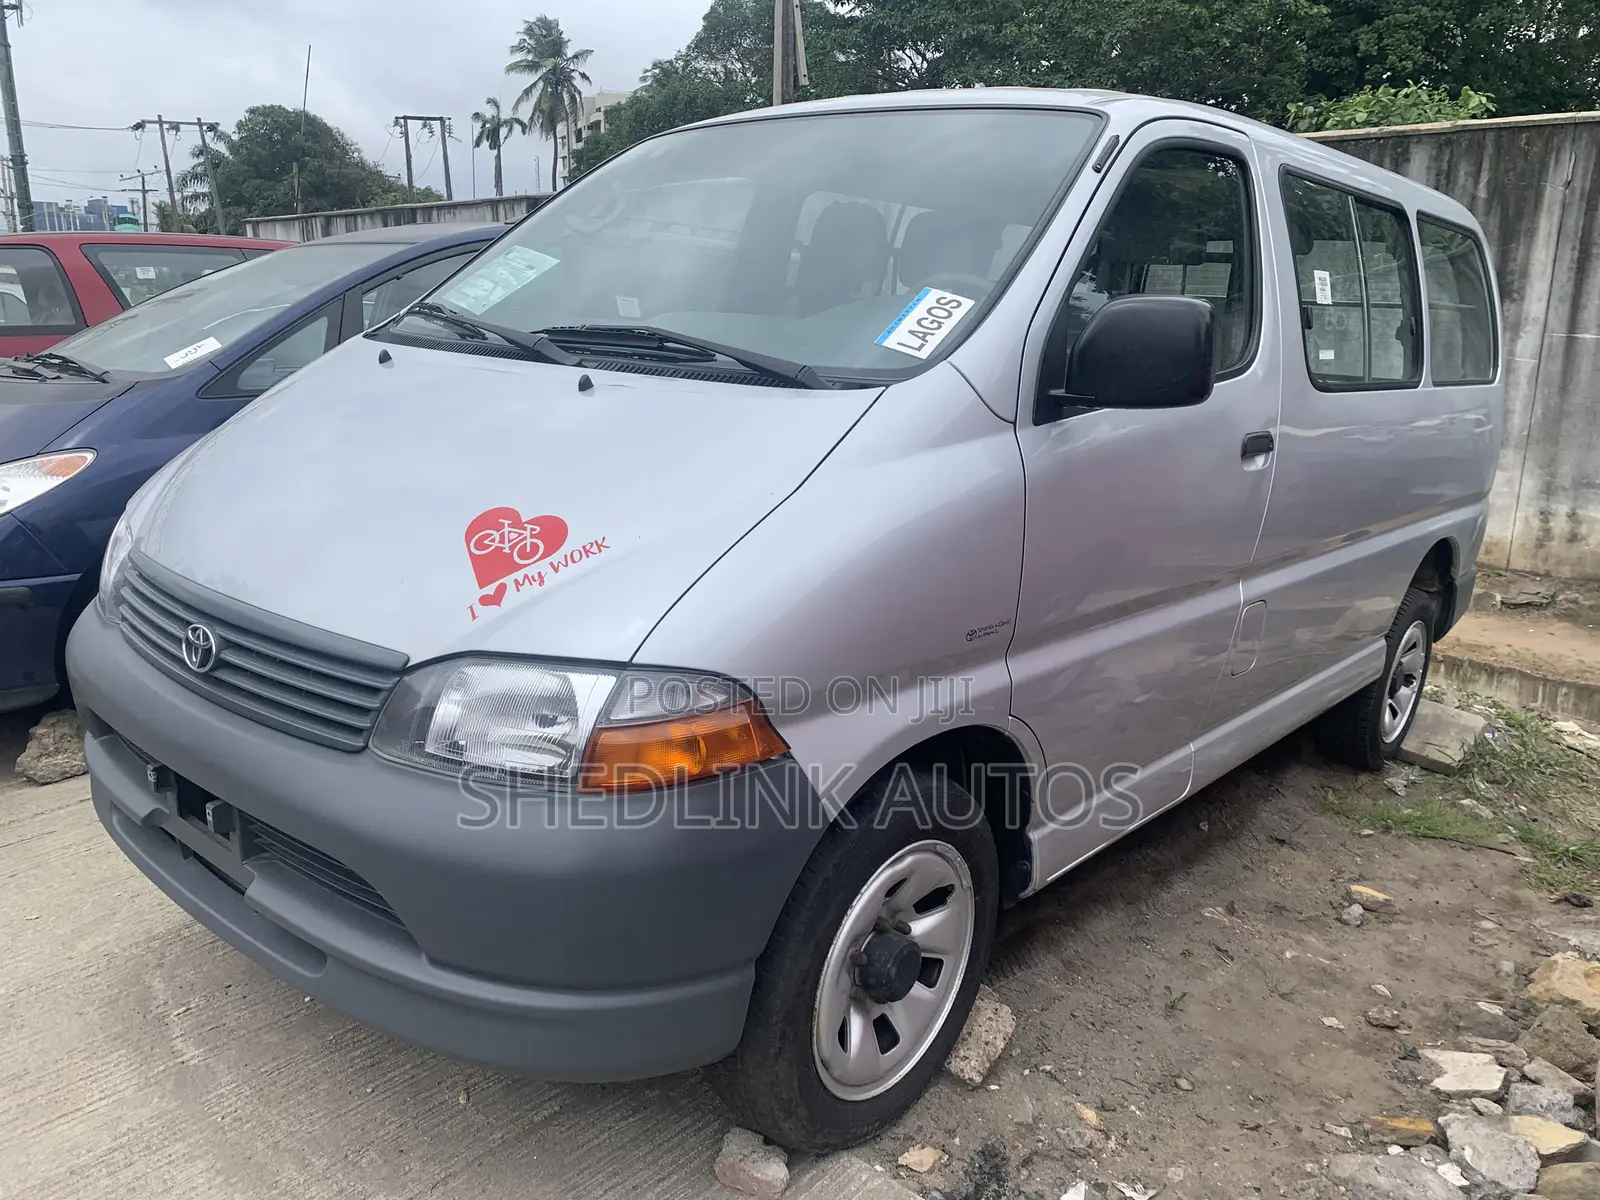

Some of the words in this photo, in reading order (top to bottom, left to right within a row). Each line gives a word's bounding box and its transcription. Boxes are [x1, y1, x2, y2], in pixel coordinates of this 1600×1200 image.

[896, 296, 963, 353] LAGOS
[465, 603, 479, 622] I
[513, 570, 548, 593] My
[549, 536, 611, 574] WORK
